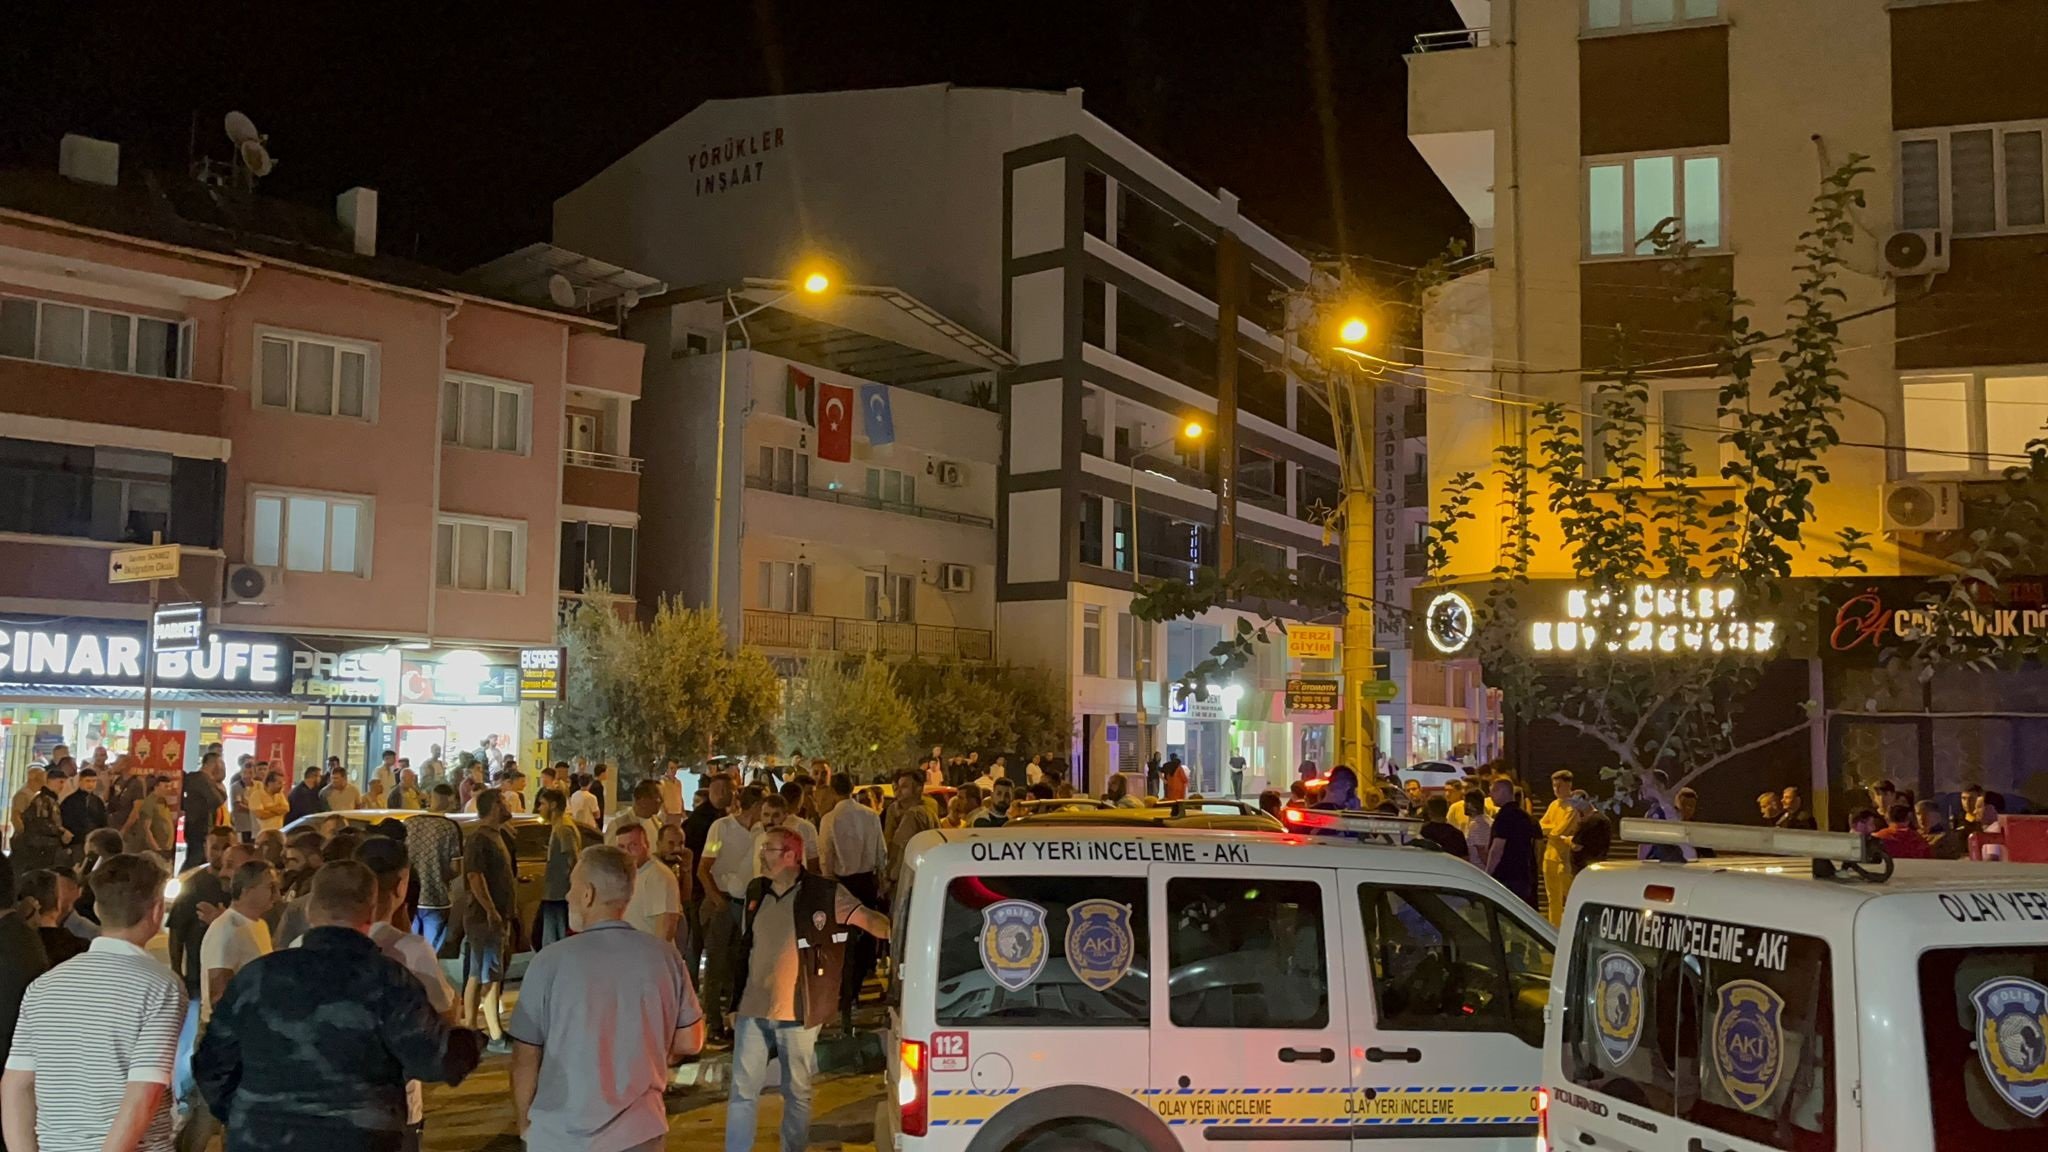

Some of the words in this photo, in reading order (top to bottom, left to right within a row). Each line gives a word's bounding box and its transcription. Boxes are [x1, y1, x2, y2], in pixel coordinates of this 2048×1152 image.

[688, 127, 784, 173] YÖRÜKLER
[1290, 631, 1331, 640] TERZİ
[1290, 642, 1331, 652] GİYİM
[971, 842, 1026, 861] OLAY
[1938, 893, 2005, 922] OLAY
[1600, 907, 1633, 942] OLAY
[936, 1035, 964, 1055] 112
[1159, 1100, 1187, 1116] OLAY
[1344, 1099, 1371, 1115] OLAY
[1553, 1087, 1608, 1117] TOURNEO
